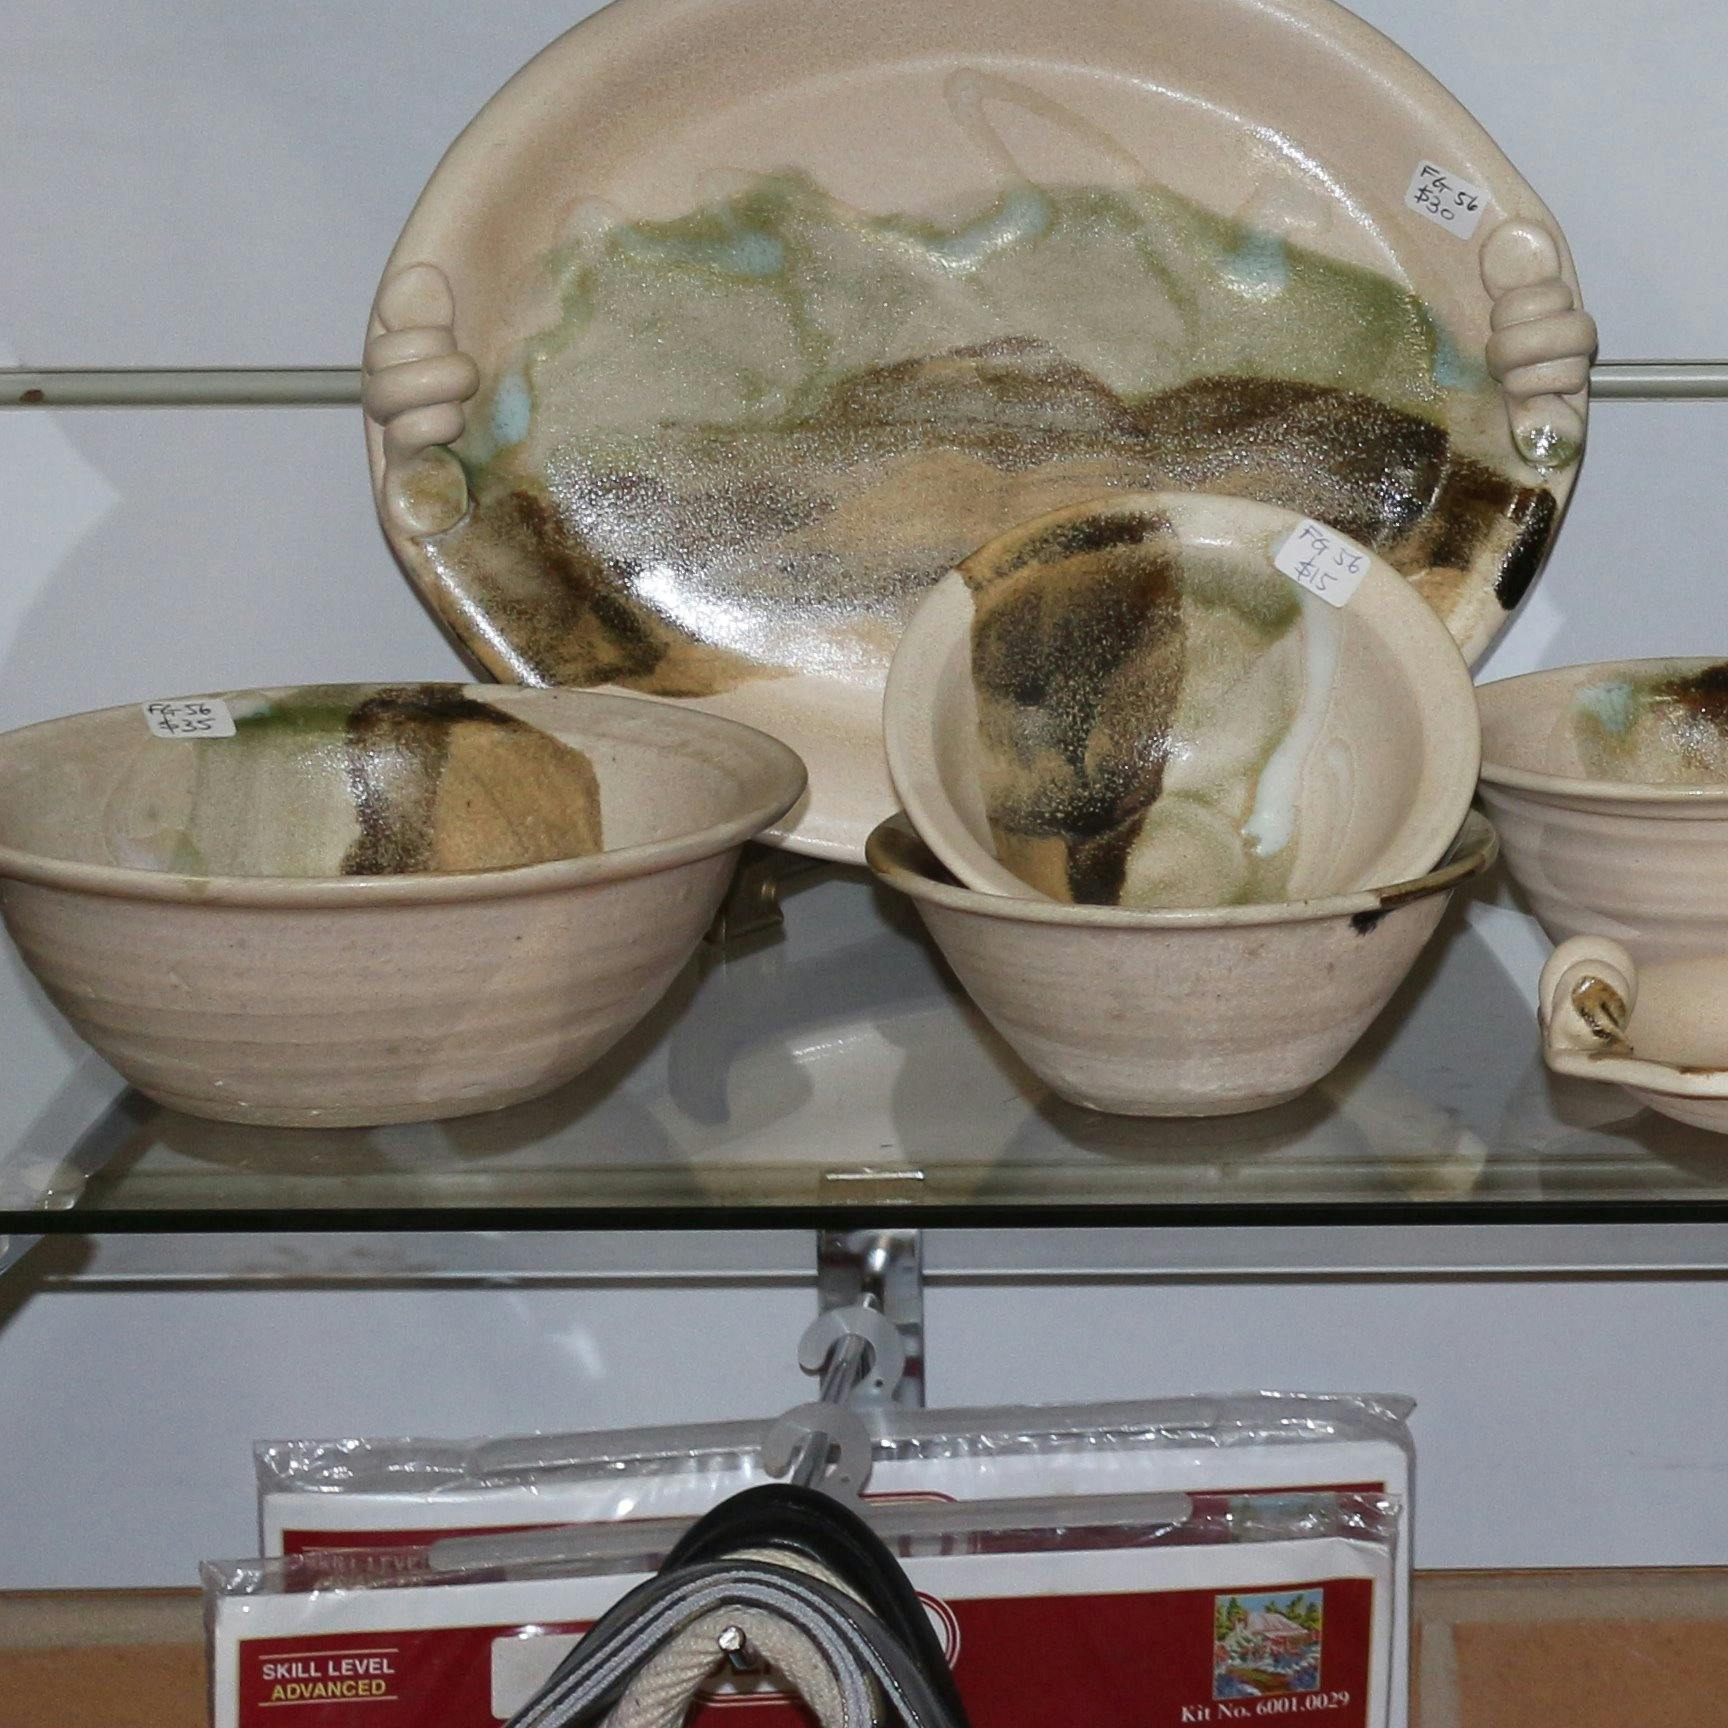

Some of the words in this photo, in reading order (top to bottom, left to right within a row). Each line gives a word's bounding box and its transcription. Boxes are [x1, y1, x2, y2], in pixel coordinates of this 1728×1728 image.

[1414, 185, 1455, 221] $30
[1333, 547, 1362, 574] 56
[1294, 555, 1338, 591] $15
[185, 703, 212, 716] 56
[159, 715, 216, 734] $35
[262, 1661, 322, 1680] SKILL
[328, 1658, 395, 1676] LEVEL
[271, 1679, 386, 1701] ADVANCED
[1181, 1704, 1210, 1723] Kit
[1217, 1703, 1250, 1720] No.
[1256, 1691, 1350, 1716] 6001.0029
